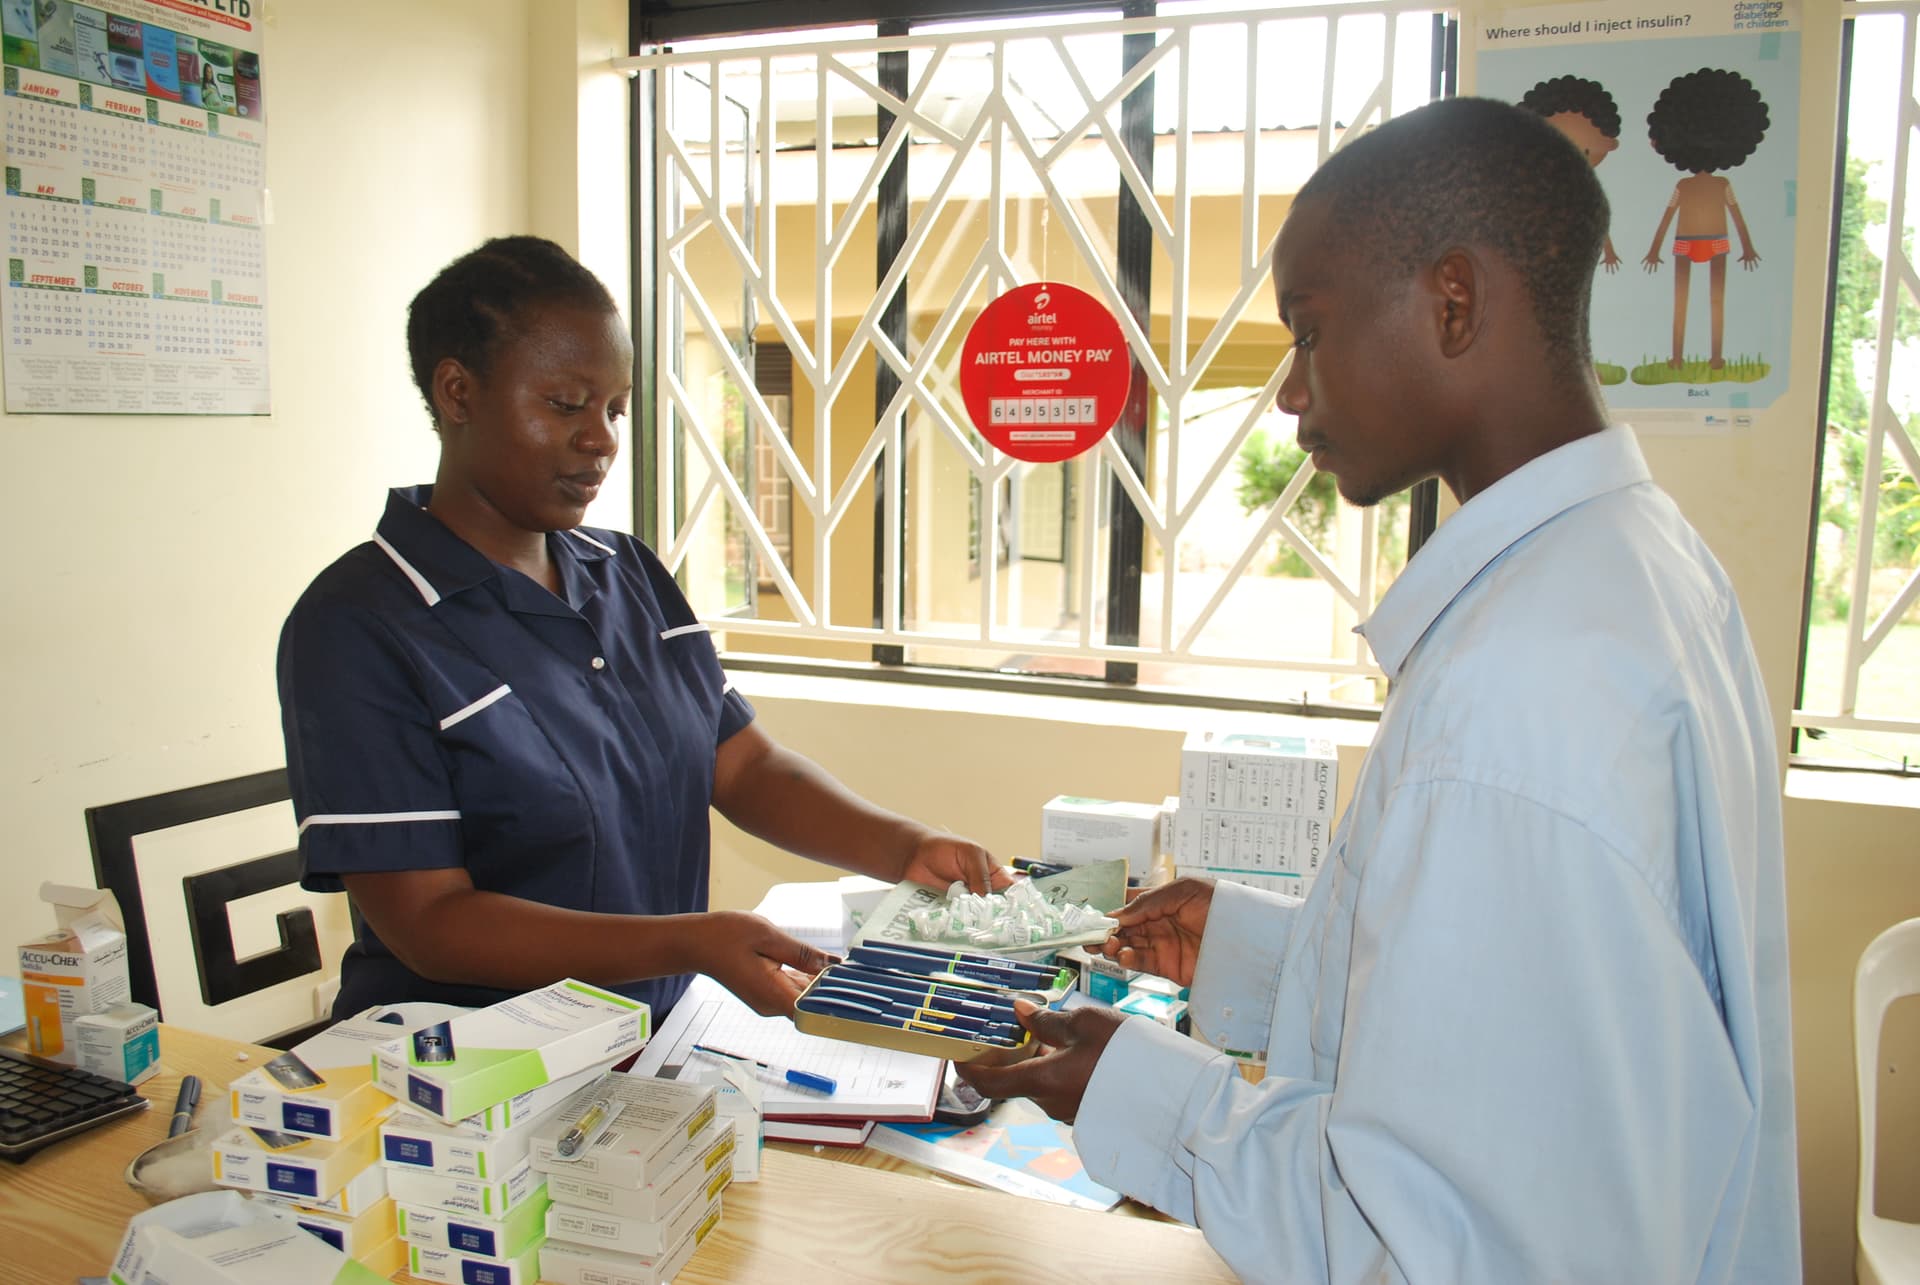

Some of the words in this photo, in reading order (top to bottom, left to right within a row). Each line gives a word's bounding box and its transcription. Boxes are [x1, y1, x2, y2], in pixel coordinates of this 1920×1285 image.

[1486, 28, 1530, 40] Where
[1535, 21, 1581, 36] should
[1586, 22, 1590, 32] I
[1594, 20, 1632, 34] inject
[1636, 14, 1691, 29] insulin?
[1746, 20, 1788, 28] children
[109, 24, 141, 38] OMEGA
[22, 82, 60, 97] JANUARY
[105, 100, 141, 115] FEBRUARY
[180, 117, 204, 128] MARCH
[37, 184, 55, 196] MAY
[118, 196, 137, 206] JUNE
[31, 274, 76, 286] SEPTEMBER
[112, 281, 144, 292] OCTOBER
[1027, 312, 1056, 324] airtel
[1009, 338, 1025, 347] PAY
[1026, 337, 1050, 346] HERE
[1052, 336, 1076, 345] WITH
[975, 352, 1024, 365] AIRTEL
[1028, 350, 1082, 364] MONEY
[1086, 349, 1112, 362] PAY
[1688, 388, 1710, 397] Back
[22, 952, 79, 966] ACCU-CHEK
